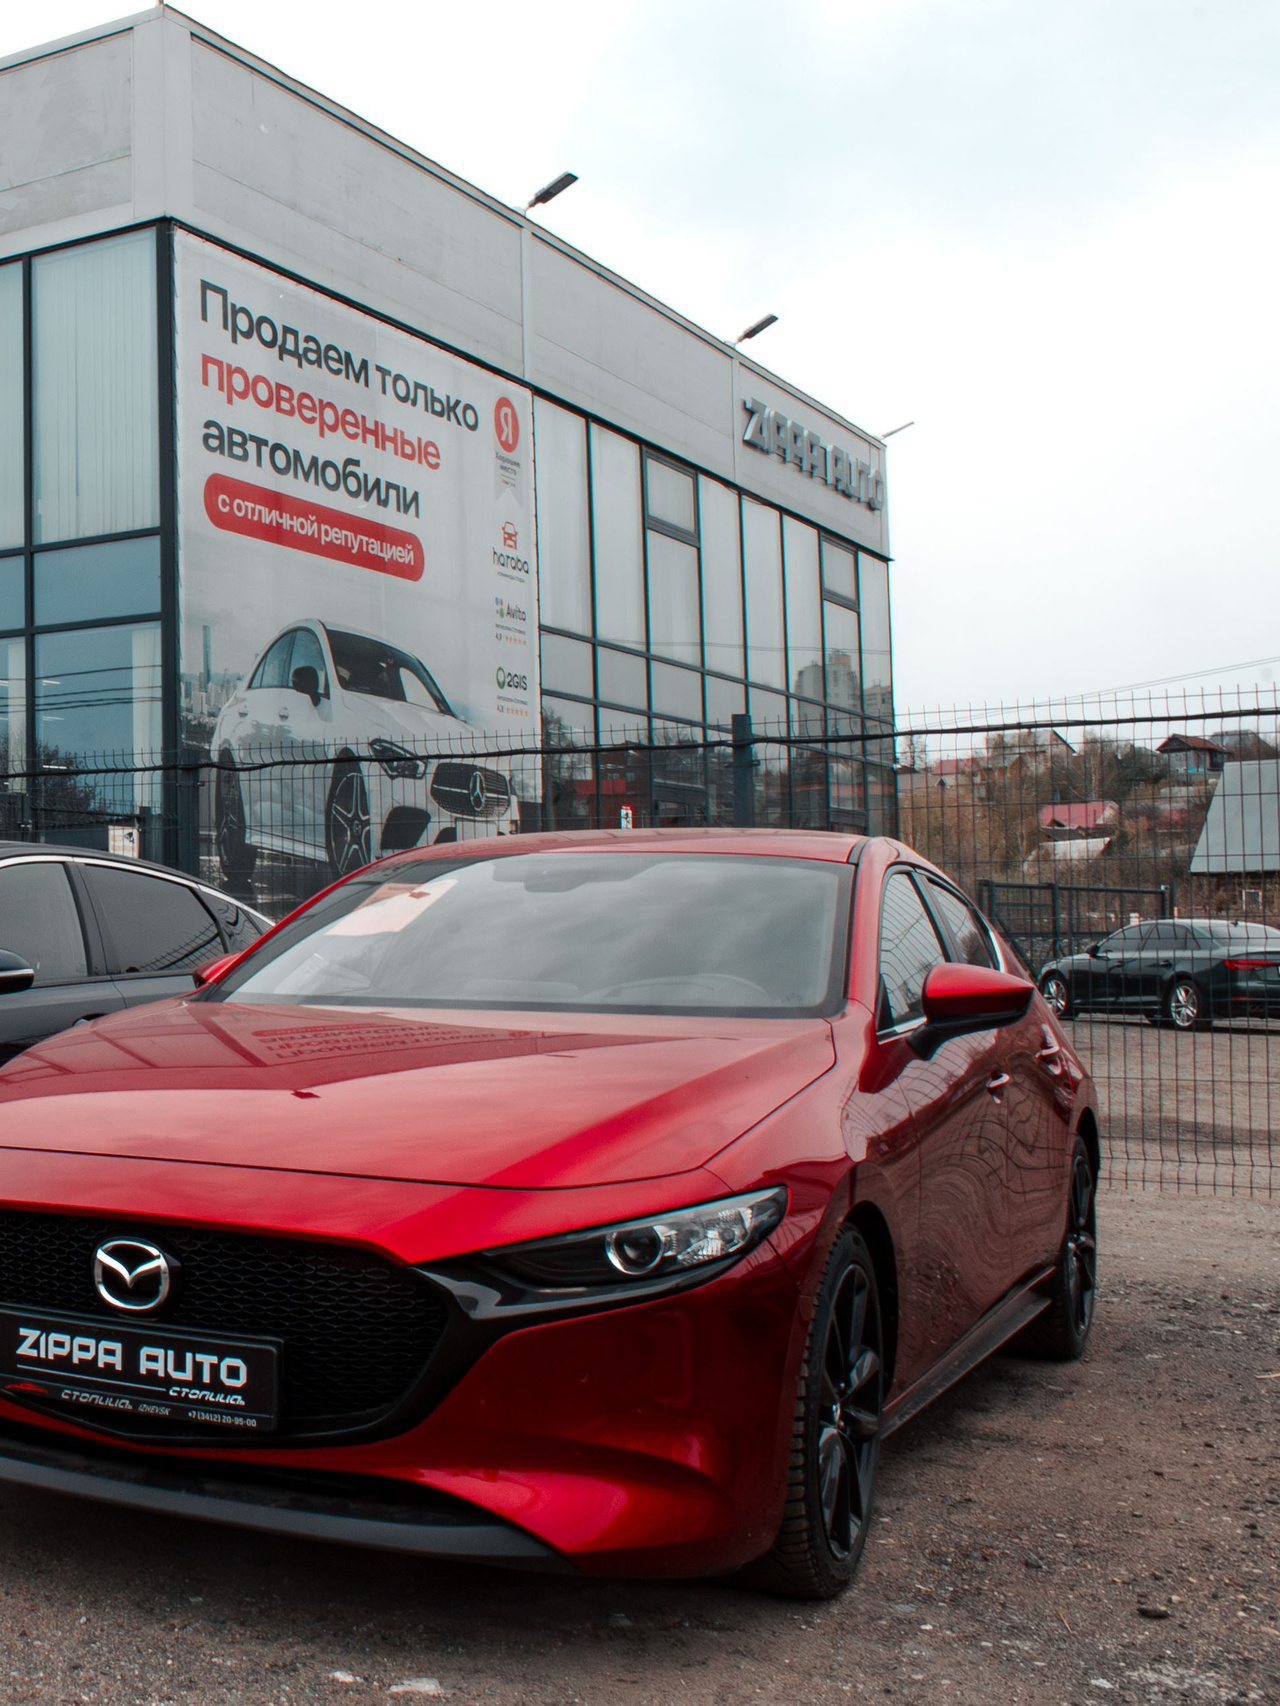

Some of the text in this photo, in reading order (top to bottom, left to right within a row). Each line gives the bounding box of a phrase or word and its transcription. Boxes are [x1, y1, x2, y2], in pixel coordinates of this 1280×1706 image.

[200, 279, 479, 432] Продаем только
[201, 353, 441, 471] проверенные
[202, 419, 420, 519] автомобили
[217, 494, 414, 566] с отличной репутацией
[492, 547, 529, 575] haraba
[506, 603, 527, 622] Avito
[506, 672, 528, 691] 2GIS
[16, 1327, 247, 1388] ZIPPA AUTO
[197, 1411, 221, 1423] (3412)
